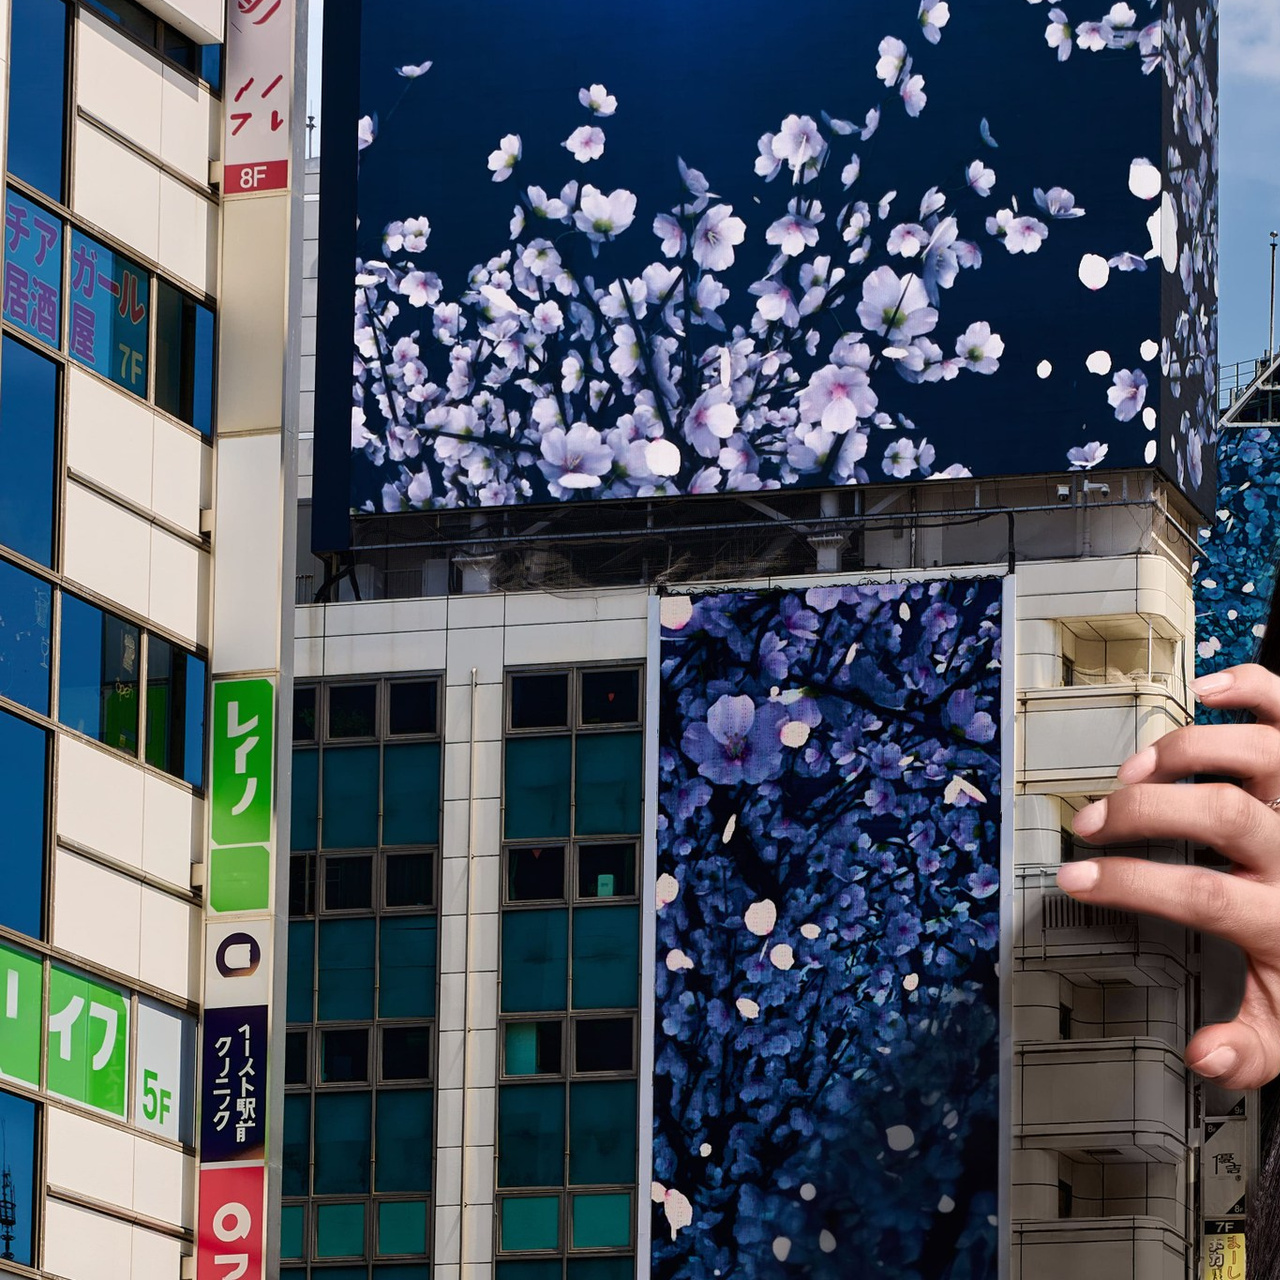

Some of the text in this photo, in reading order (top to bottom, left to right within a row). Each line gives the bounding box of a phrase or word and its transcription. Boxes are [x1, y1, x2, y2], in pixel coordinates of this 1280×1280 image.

[240, 166, 267, 188] 8F
[5, 203, 146, 325] チアガール
[3, 261, 96, 365] 居酒屋
[119, 343, 143, 385] 7F
[143, 1068, 172, 1125] 5F
[1215, 1221, 1235, 1233] 7F
